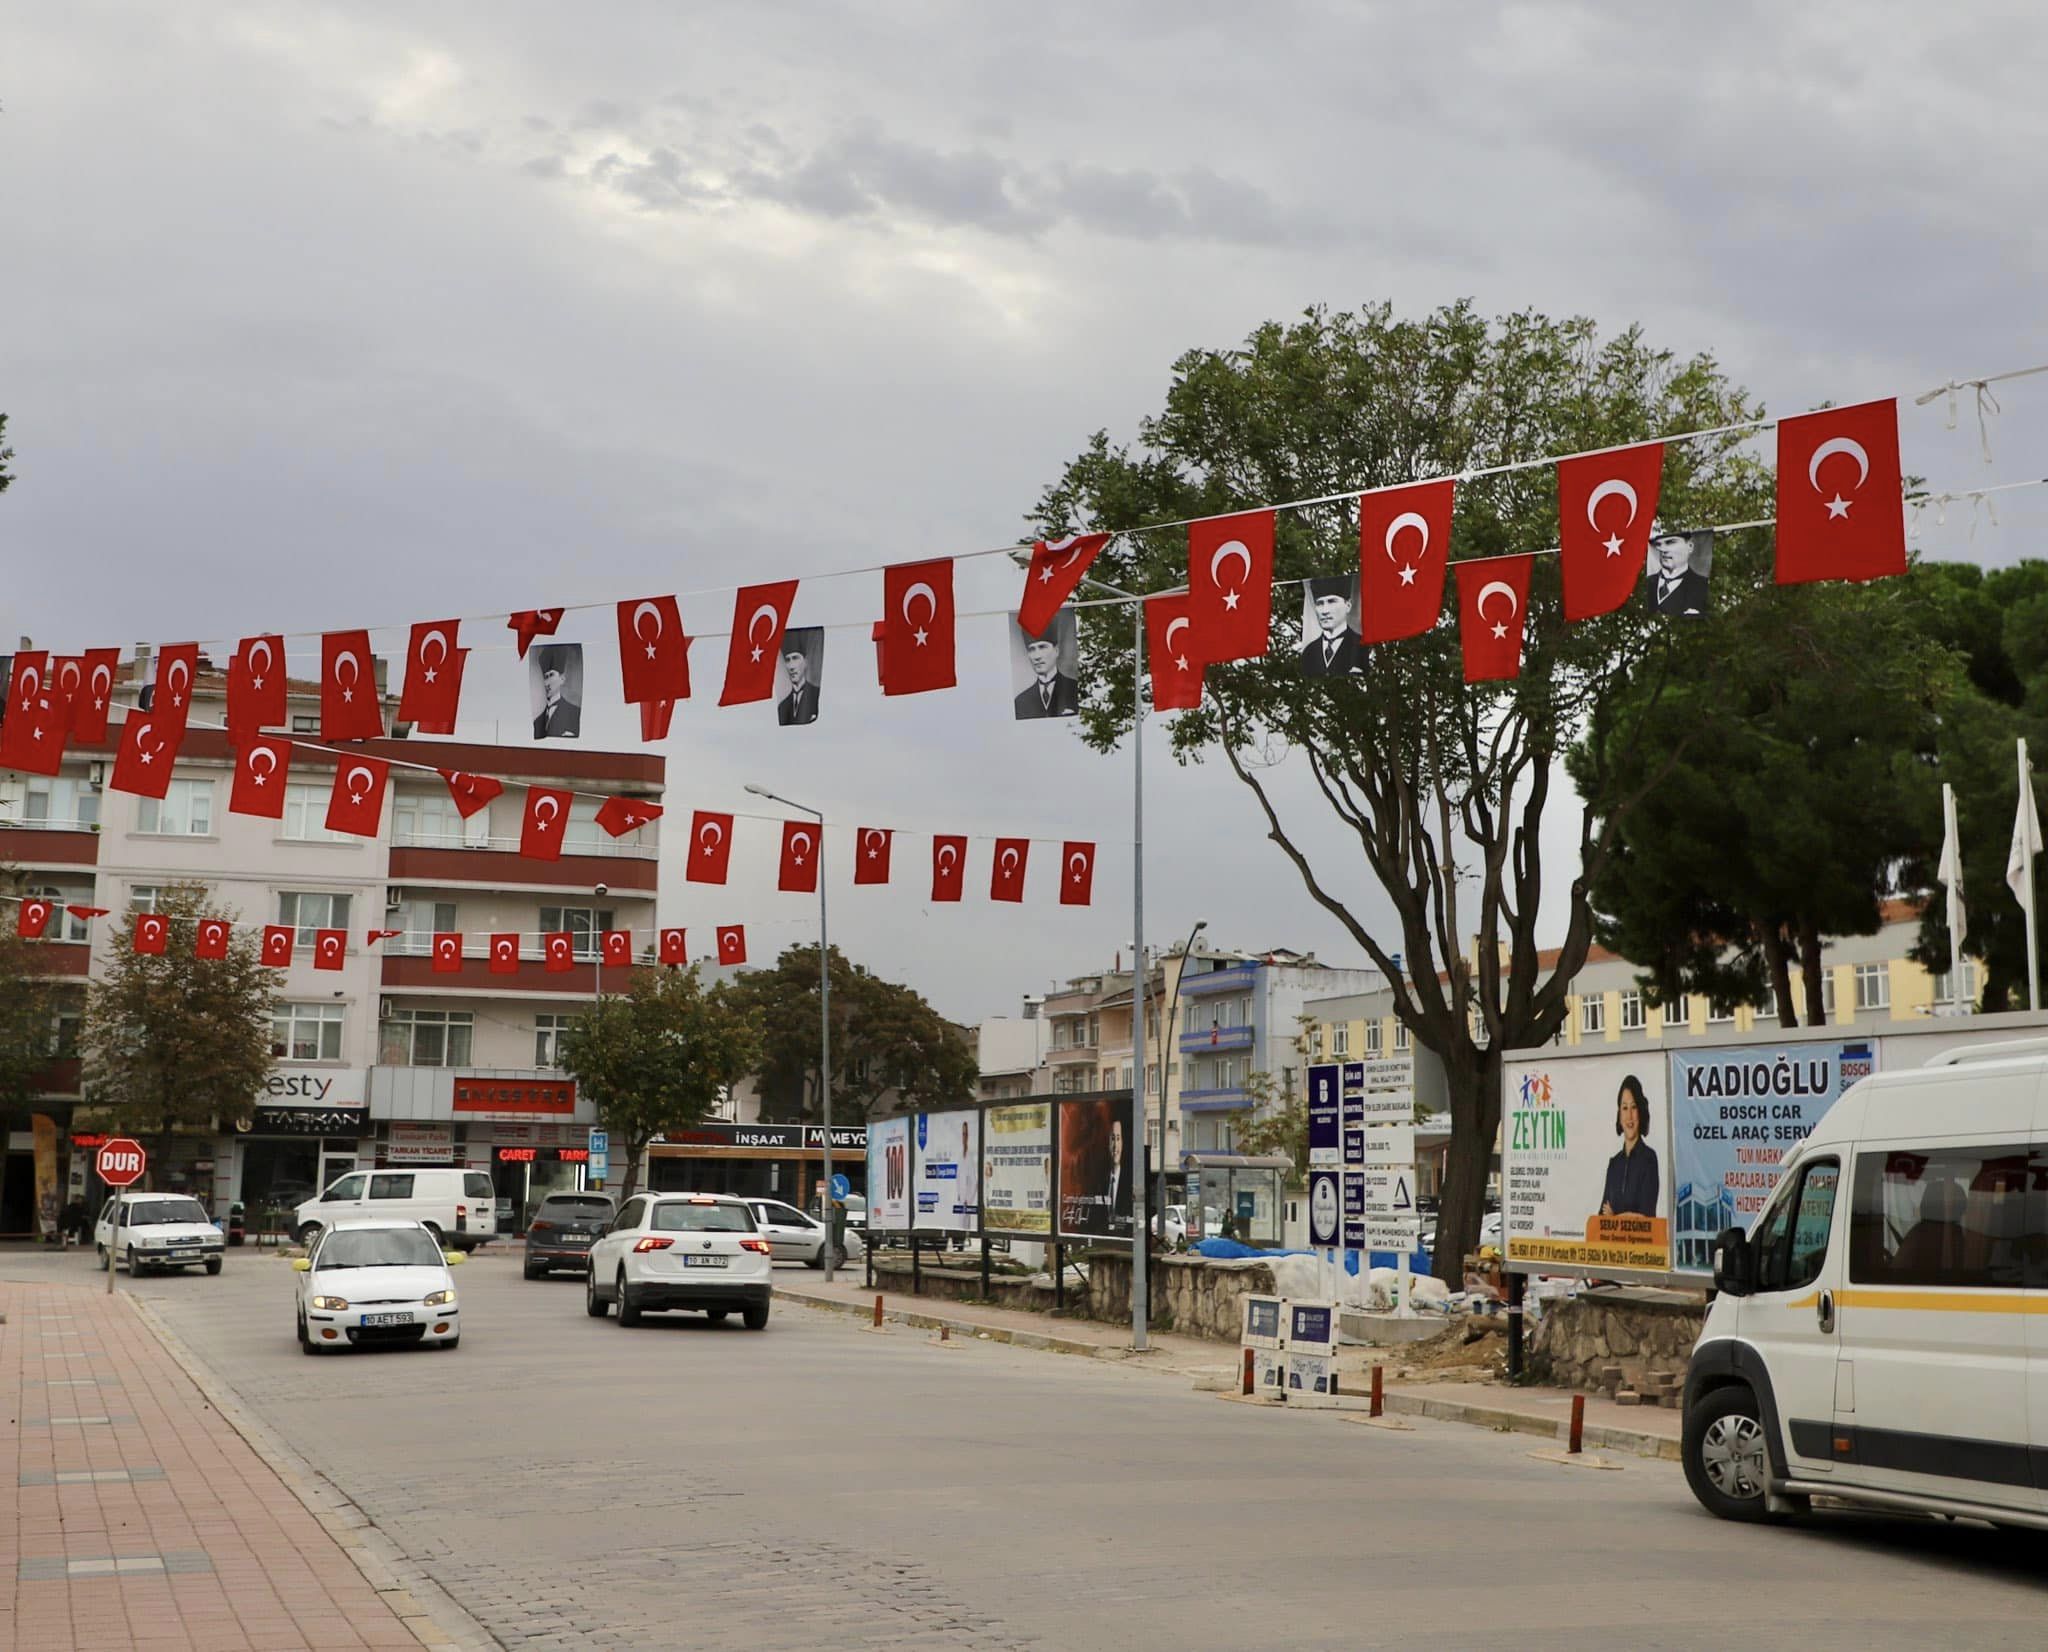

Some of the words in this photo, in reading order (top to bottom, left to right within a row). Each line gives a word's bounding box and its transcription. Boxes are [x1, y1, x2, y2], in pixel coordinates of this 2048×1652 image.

[1687, 1056, 1829, 1097] KADIOĞLU
[1841, 1063, 1871, 1077] BOSCH
[263, 1112, 360, 1125] TARKAN
[1720, 1106, 1767, 1120] BOSCH
[1772, 1105, 1802, 1119] CAR
[1512, 1104, 1566, 1149] ZEYTİN
[1694, 1122, 1728, 1140] ÖZEL
[1732, 1125, 1770, 1143] ARAÇ
[736, 1131, 786, 1146] İNŞAAT
[390, 1147, 419, 1156] TARKAN
[499, 1149, 536, 1161] CARET
[1736, 1147, 1754, 1163] TÜM
[102, 1152, 140, 1172] DUR
[886, 1144, 904, 1200] 100
[1724, 1172, 1766, 1189] ARAÇLARA
[688, 1256, 697, 1265] 10
[701, 1256, 710, 1265] AN
[714, 1256, 727, 1265] 072
[367, 1316, 375, 1325] 10
[377, 1315, 394, 1324] AET
